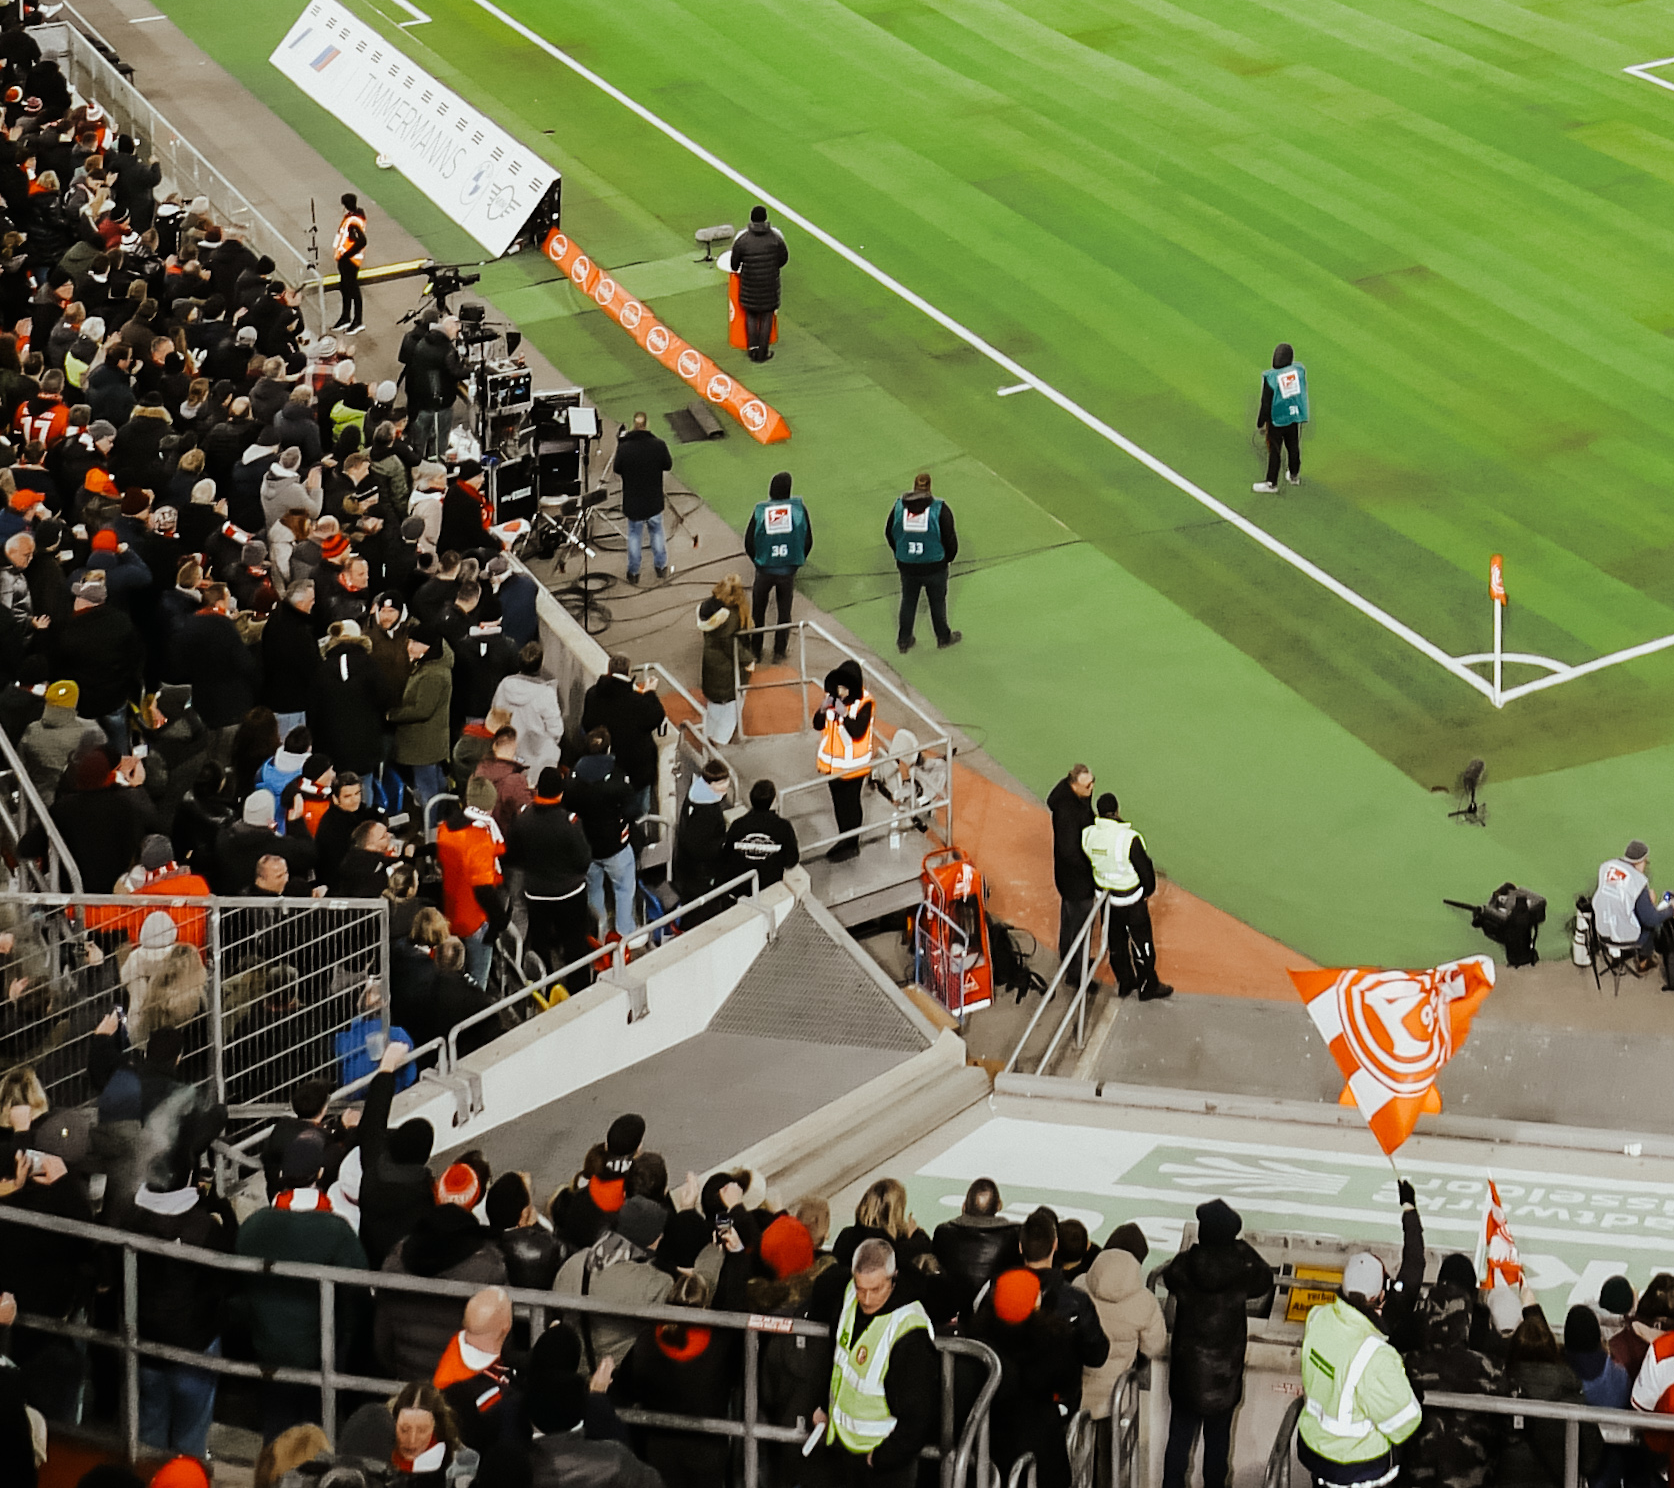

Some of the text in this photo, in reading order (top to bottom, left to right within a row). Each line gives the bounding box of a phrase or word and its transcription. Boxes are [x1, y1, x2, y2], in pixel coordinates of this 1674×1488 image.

[355, 72, 467, 179] TIMMERMANNS
[20, 416, 52, 447] 17
[771, 543, 788, 557] 36
[908, 541, 924, 555] 33
